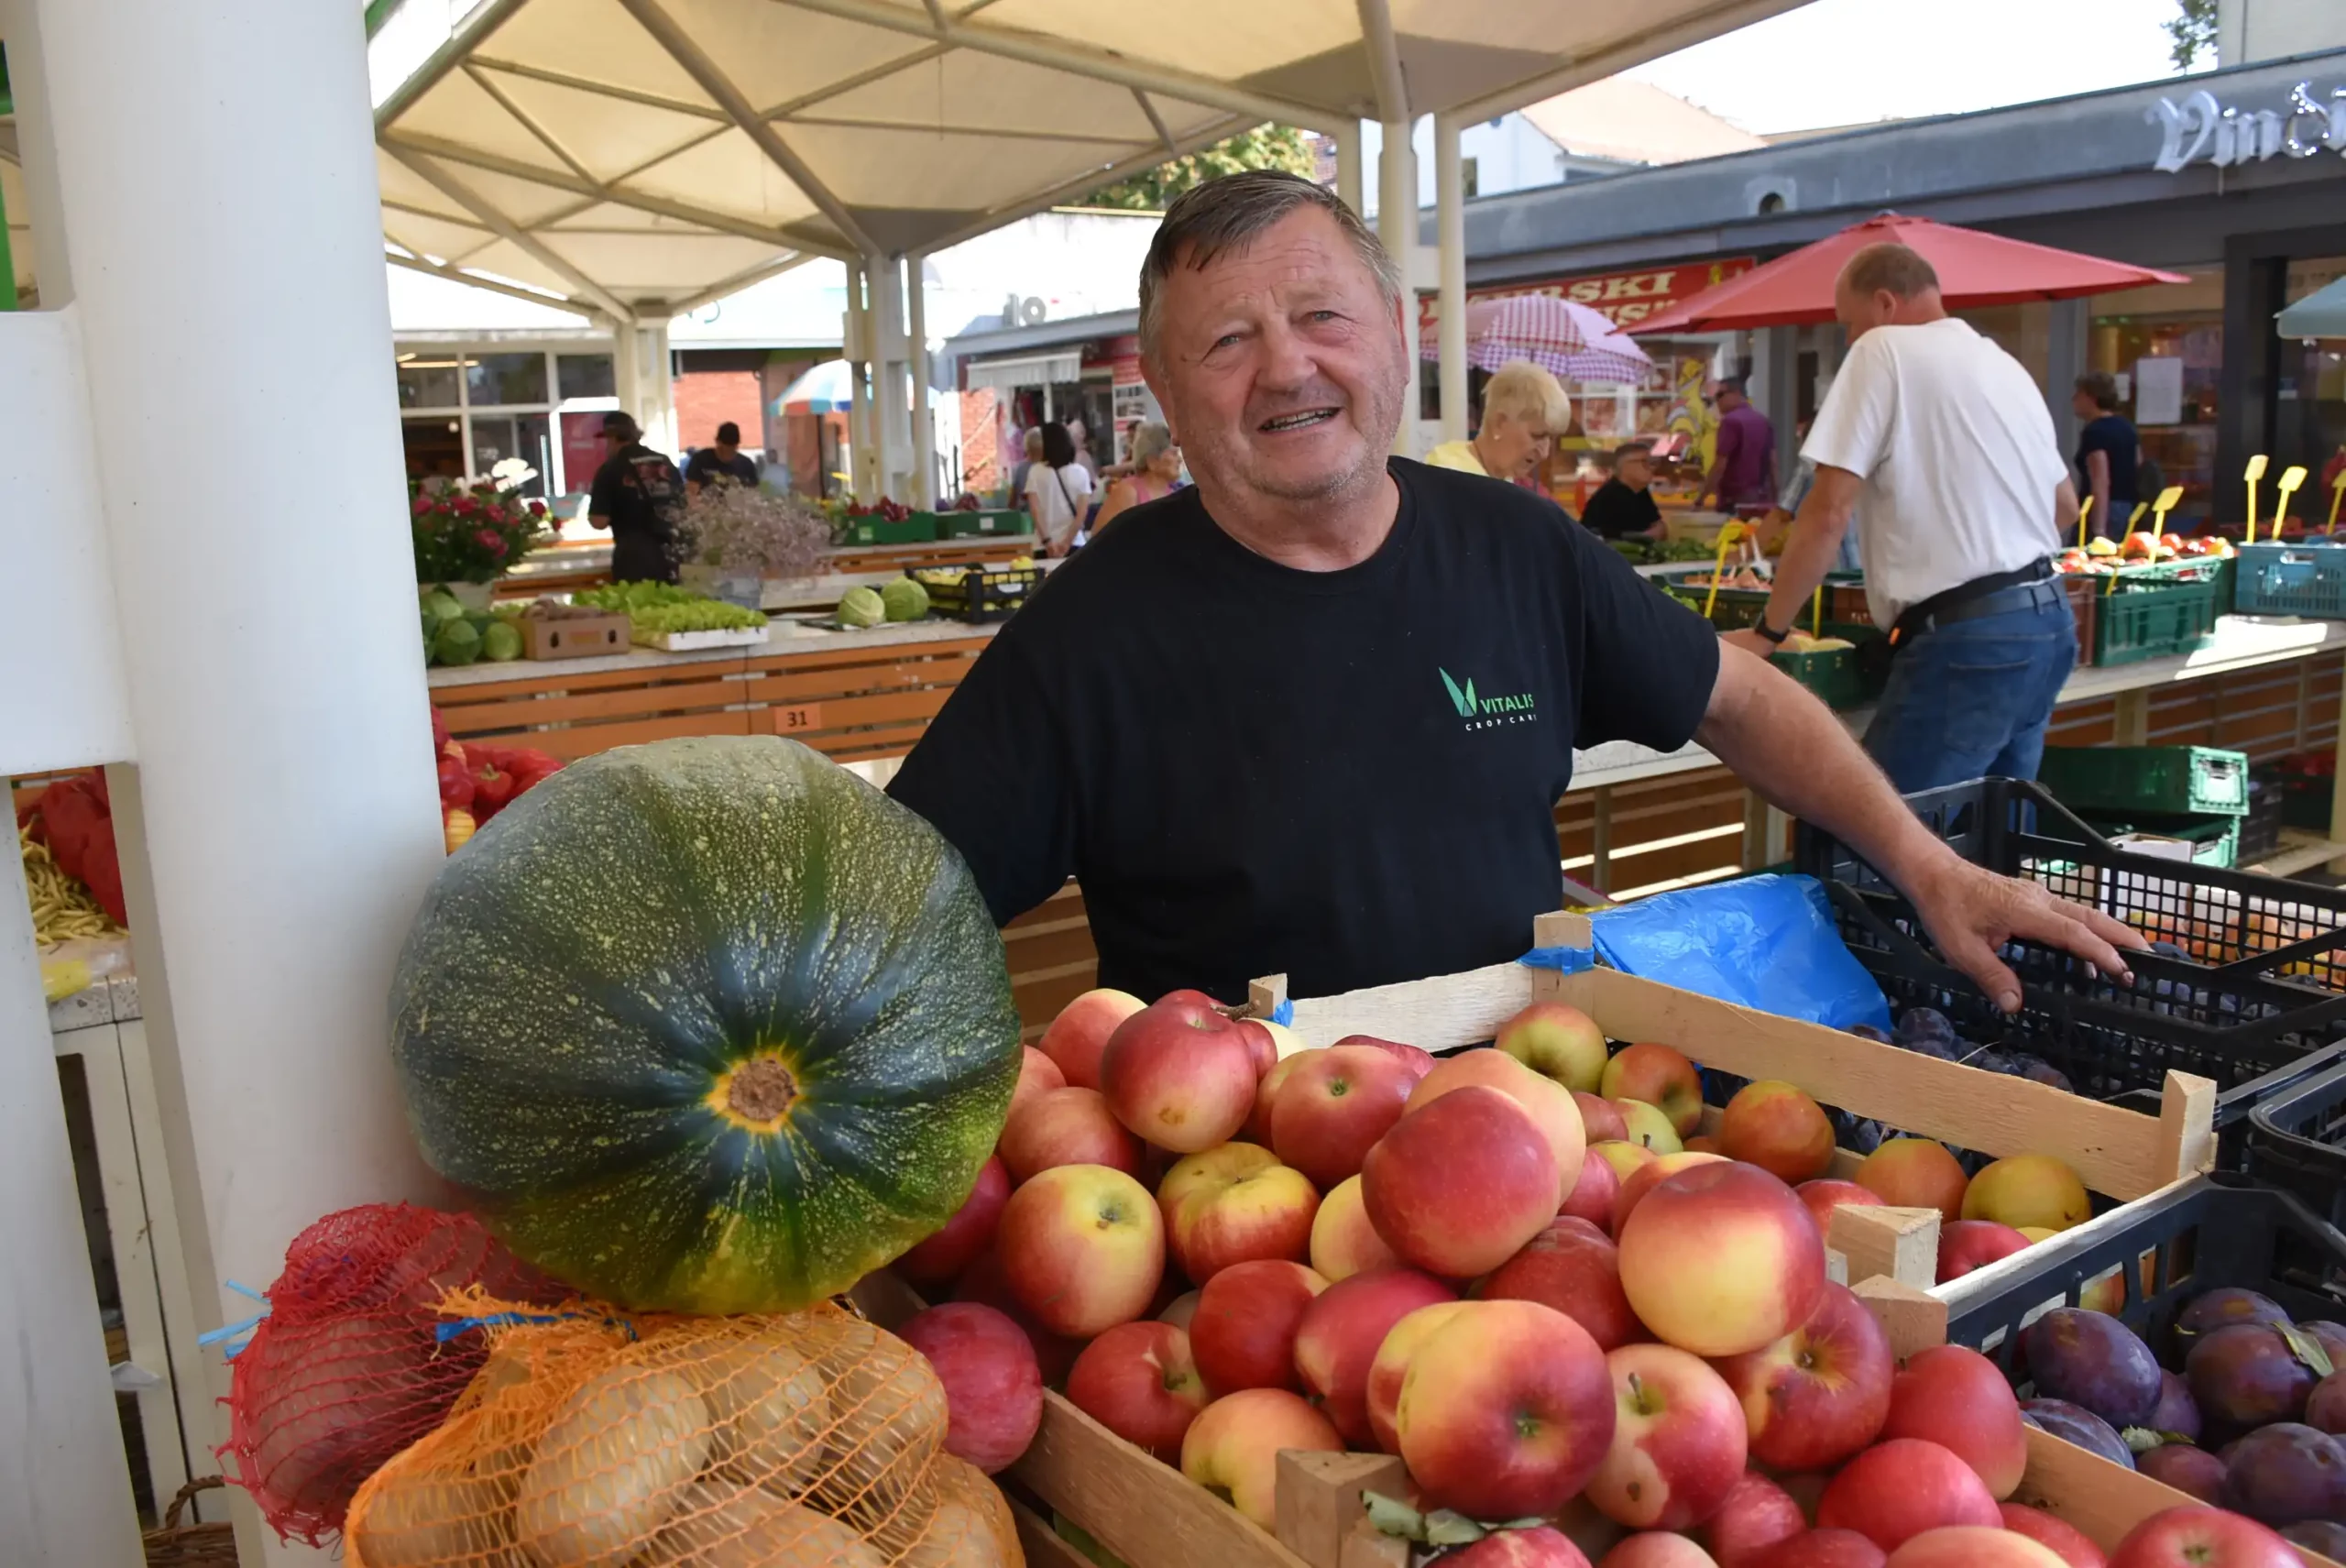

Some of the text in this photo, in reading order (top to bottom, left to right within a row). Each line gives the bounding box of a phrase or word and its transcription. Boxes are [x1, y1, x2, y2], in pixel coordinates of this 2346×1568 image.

[1480, 694, 1534, 714] VITALIS
[787, 710, 808, 728] 31
[1465, 718, 1502, 731] CROP
